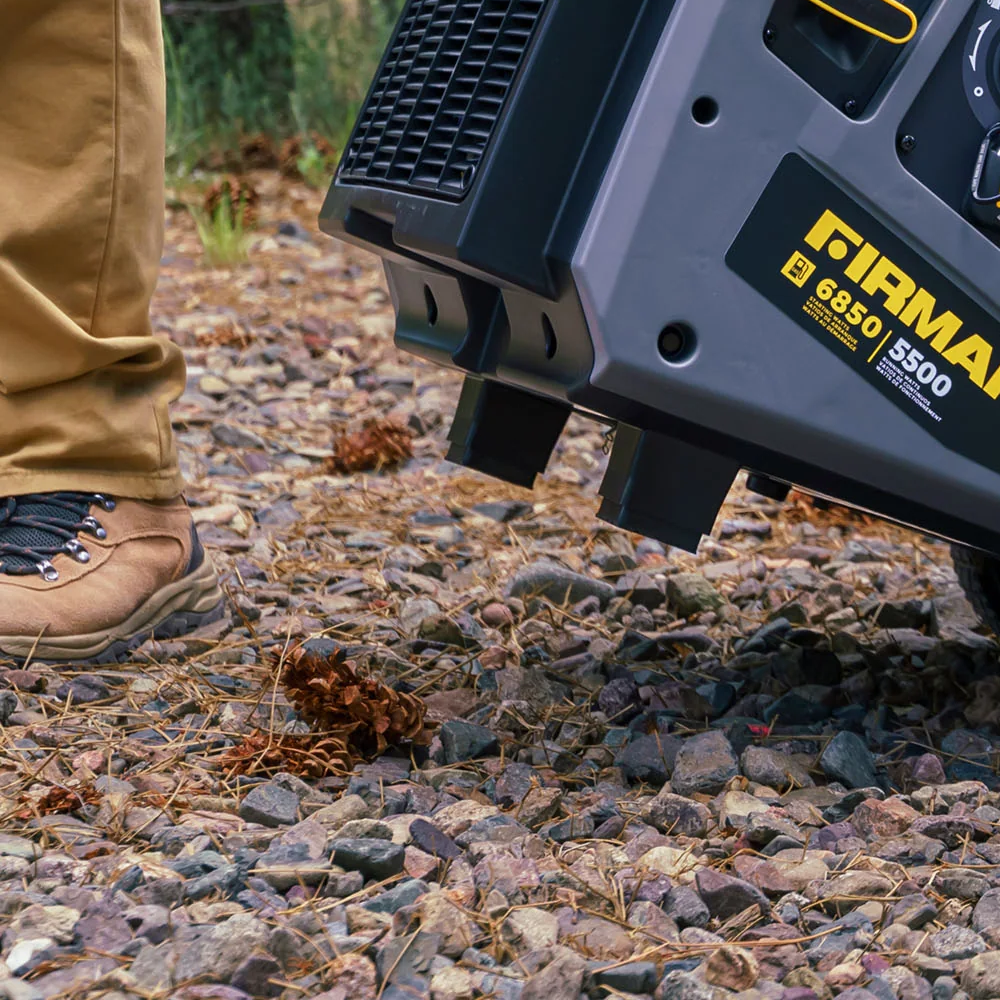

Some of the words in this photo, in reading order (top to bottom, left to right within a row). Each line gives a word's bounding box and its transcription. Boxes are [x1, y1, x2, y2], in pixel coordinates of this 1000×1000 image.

[802, 304, 819, 321] WATTS
[818, 319, 827, 327] AU
[806, 300, 824, 317] VATIOS
[823, 315, 831, 323] DE
[828, 321, 858, 345] ARRANQUE
[808, 295, 833, 317] STARTING
[832, 315, 850, 331] WATTS
[815, 278, 883, 339] 6850
[877, 360, 896, 377] VATIOS
[895, 375, 903, 383] DE
[900, 381, 931, 406] CONTINUOS
[881, 356, 904, 377] RUNNING
[904, 374, 920, 390] WATTS
[887, 336, 953, 398] 5500
[875, 365, 892, 381] WATTS
[891, 378, 899, 386] DE
[898, 384, 942, 422] FONCTIONNEMENT
